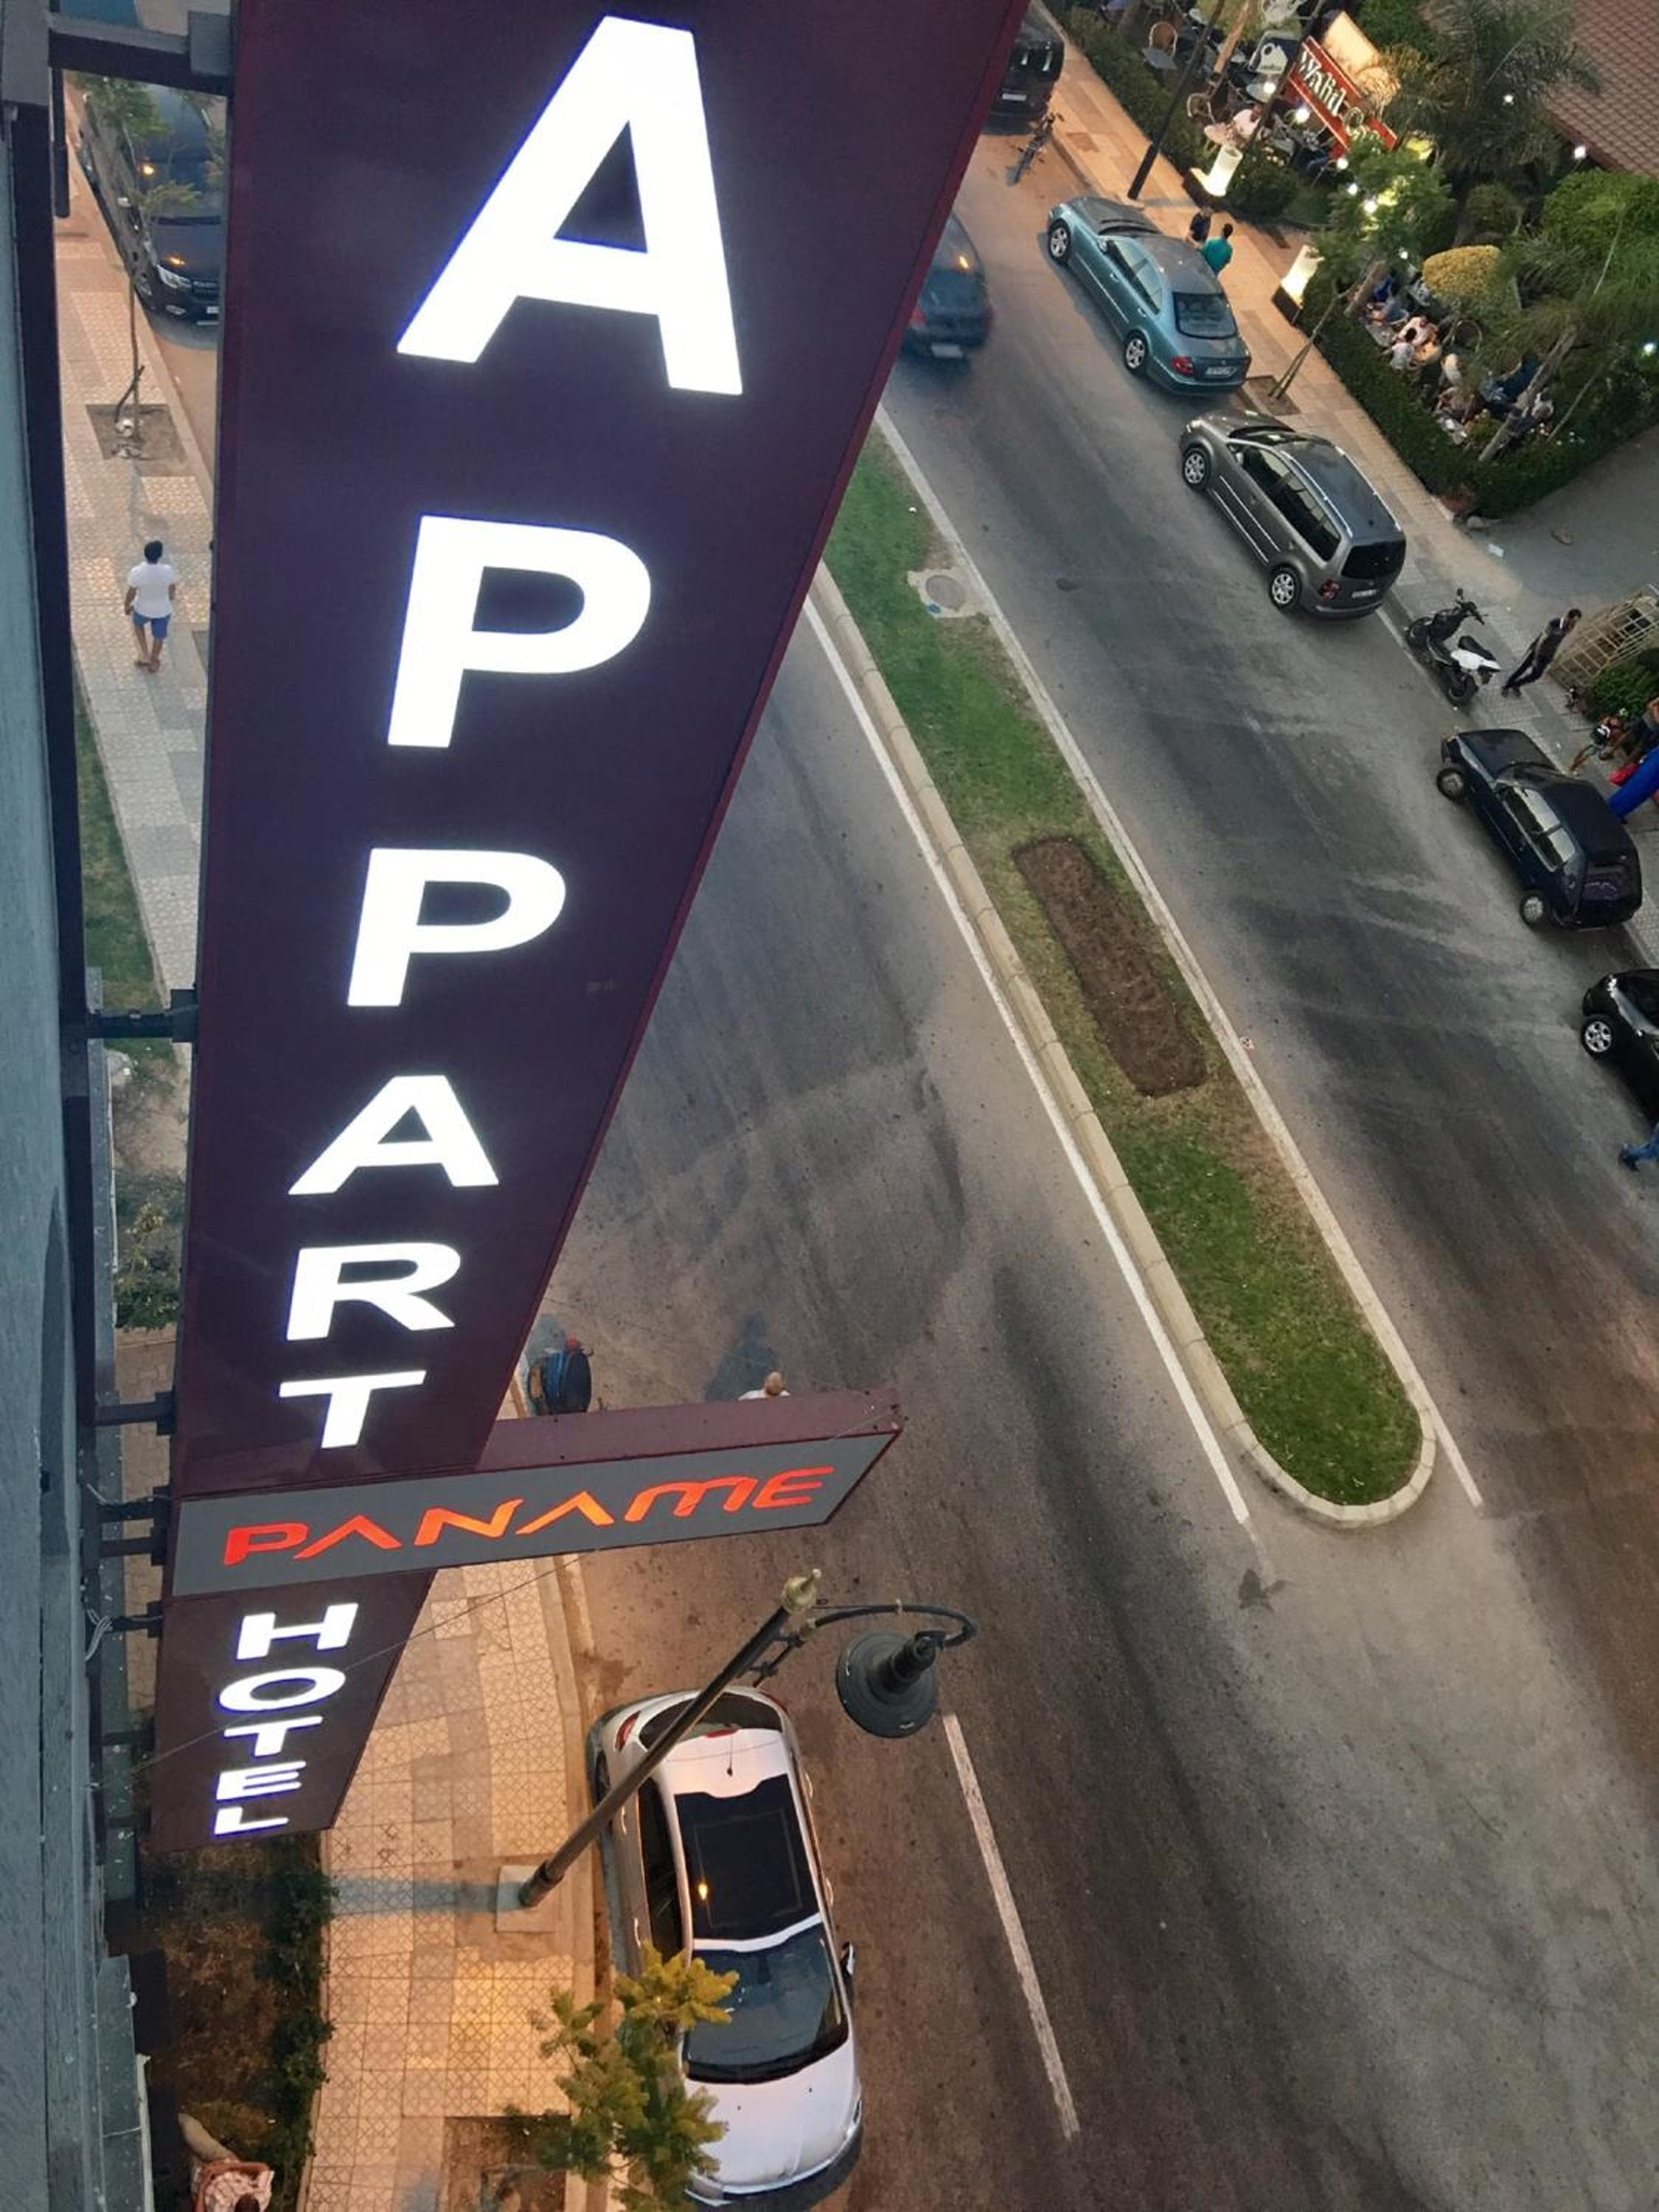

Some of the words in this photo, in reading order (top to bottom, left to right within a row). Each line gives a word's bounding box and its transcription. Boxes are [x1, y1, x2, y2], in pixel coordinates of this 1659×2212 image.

[280, 16, 742, 1448] APPART
[224, 1467, 836, 1566] PANAME
[215, 1602, 358, 1835] HOTEL
